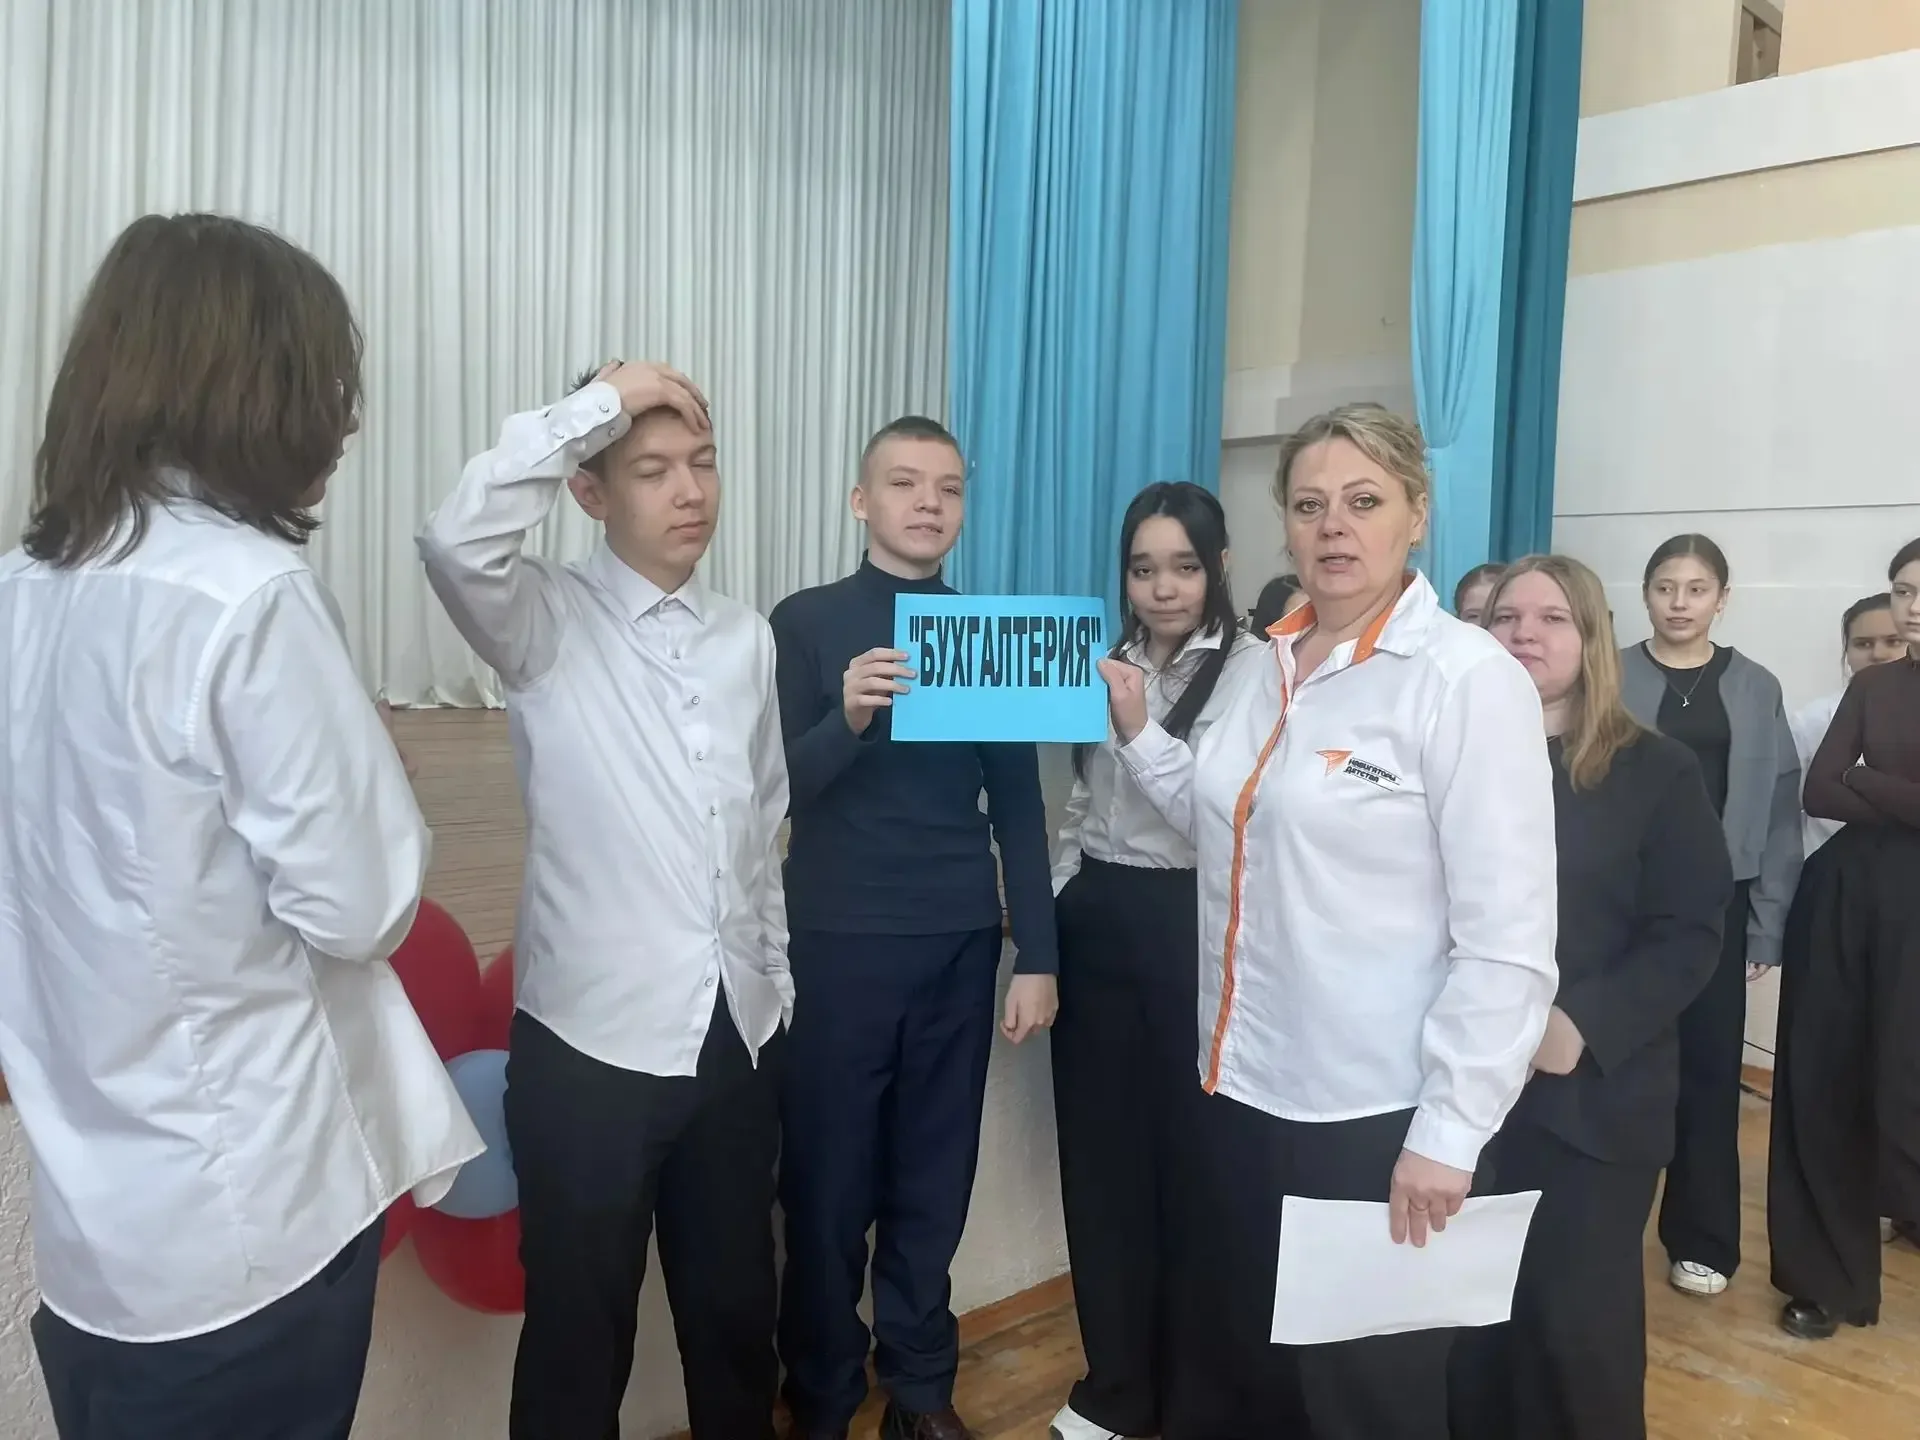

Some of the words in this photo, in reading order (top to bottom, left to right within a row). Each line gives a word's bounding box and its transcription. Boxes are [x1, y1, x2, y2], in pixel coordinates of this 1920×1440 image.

[909, 616, 1101, 687] "БУХГАЛТЕРИЯ"
[1343, 766, 1380, 783] ДЕТСТВА
[1347, 758, 1397, 782] НАВИГАТОРЫ
